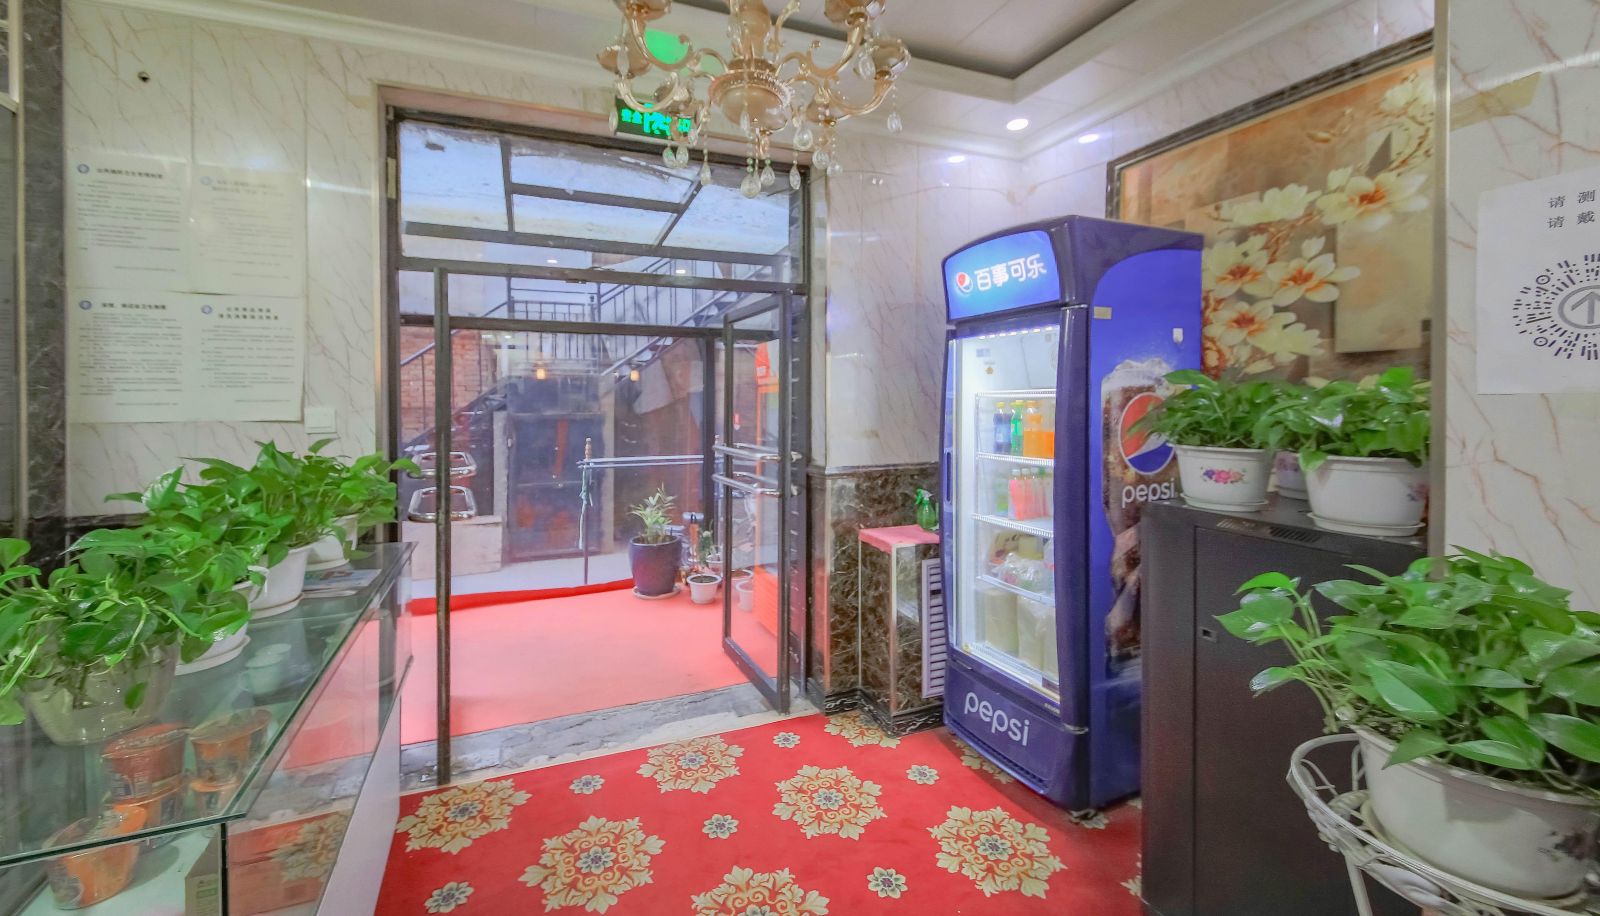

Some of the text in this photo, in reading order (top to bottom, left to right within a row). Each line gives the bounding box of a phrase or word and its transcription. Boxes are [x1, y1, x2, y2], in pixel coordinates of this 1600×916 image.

[974, 254, 1047, 291] 百事可乐
[1122, 478, 1175, 508] pepsi
[964, 692, 1030, 746] pepsi
